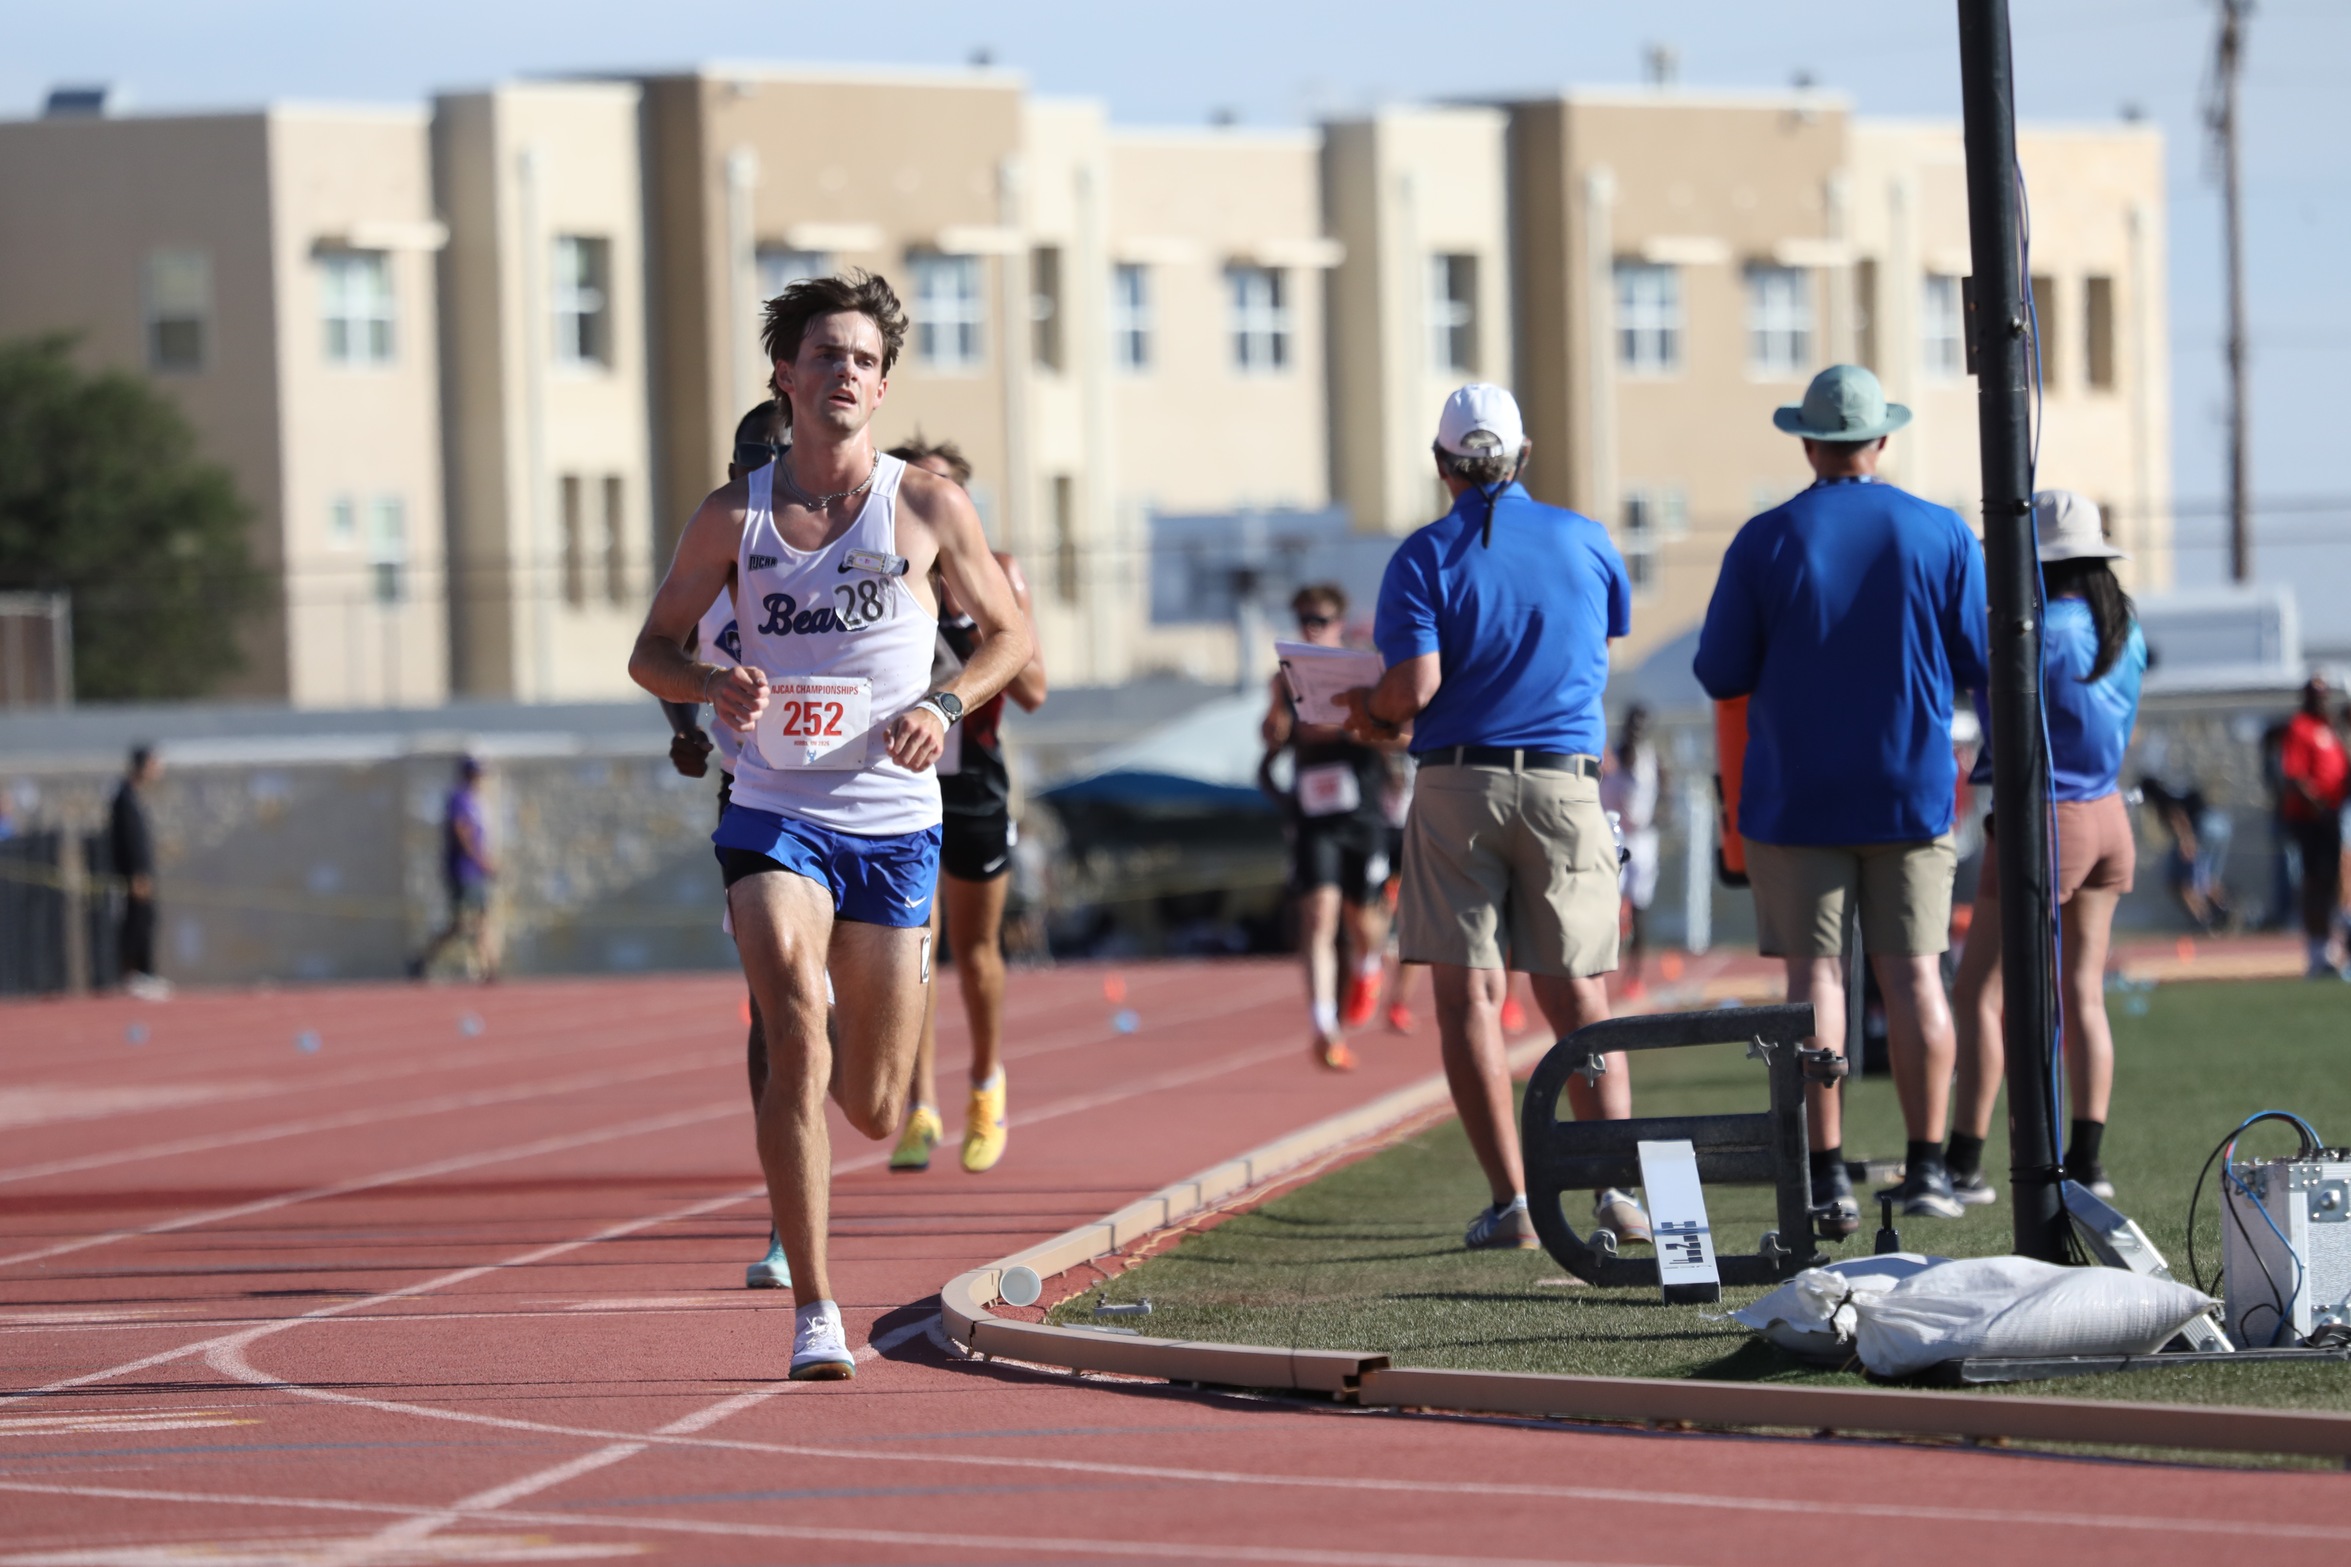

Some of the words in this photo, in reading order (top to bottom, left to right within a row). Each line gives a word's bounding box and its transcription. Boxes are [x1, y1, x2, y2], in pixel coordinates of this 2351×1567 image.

[749, 554, 778, 571] NJCAA
[758, 593, 869, 636] Bea
[771, 684, 794, 694] NJCAA
[796, 684, 859, 695] CHAMPIONSHIPS
[783, 701, 844, 736] 252
